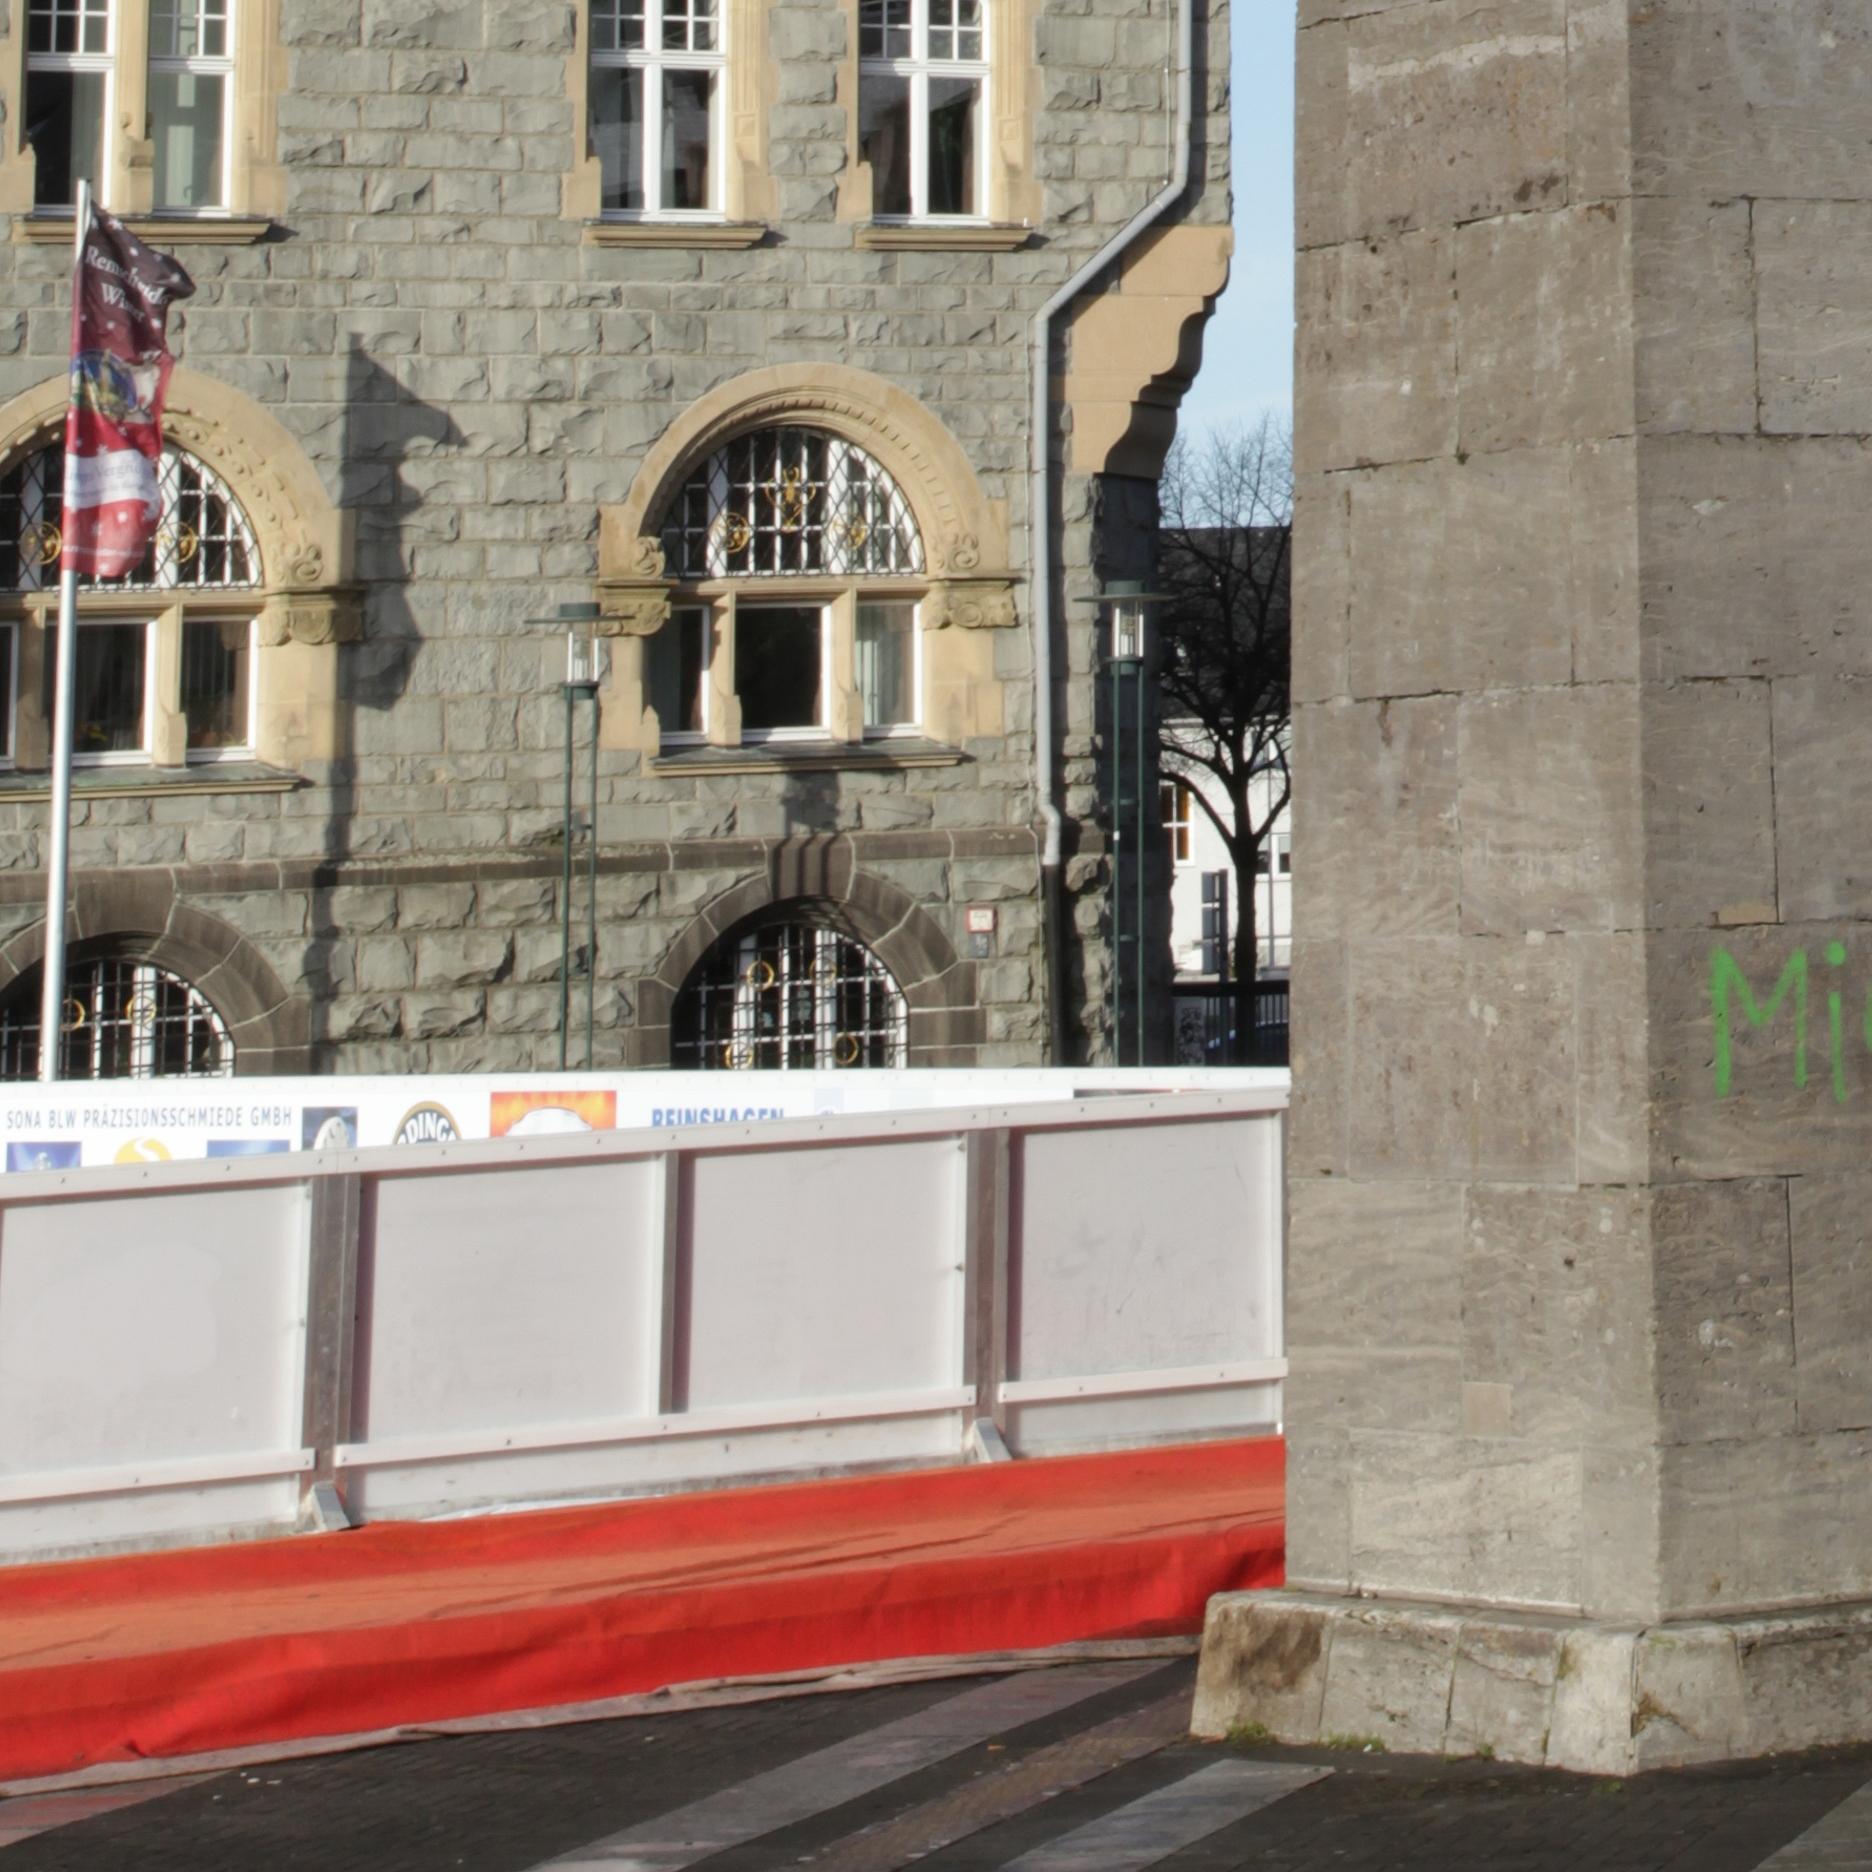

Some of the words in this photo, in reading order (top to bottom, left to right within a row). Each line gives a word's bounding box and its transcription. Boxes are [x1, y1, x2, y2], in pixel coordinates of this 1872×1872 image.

[7, 1109, 42, 1129] SONA
[49, 1109, 76, 1129] BLW
[84, 1104, 243, 1129] PRÄZISIONSSCHMIEDE
[251, 1107, 292, 1126] GMBH
